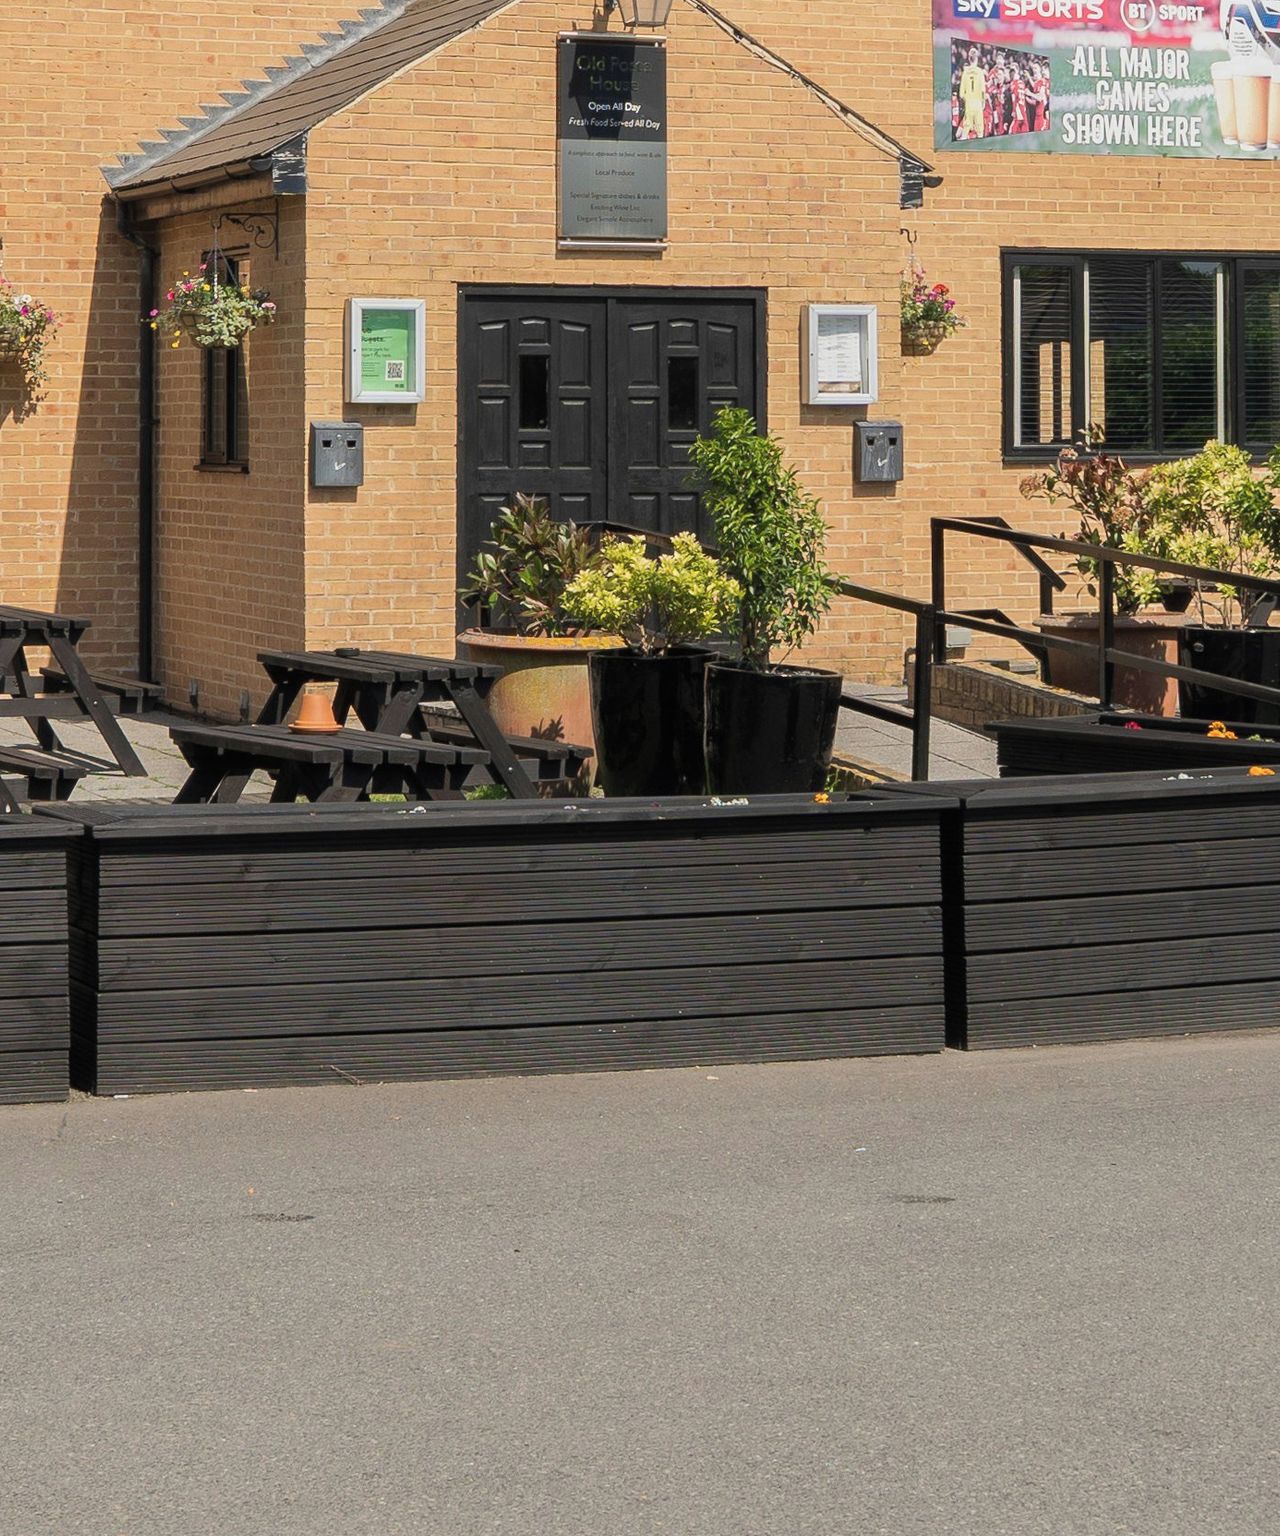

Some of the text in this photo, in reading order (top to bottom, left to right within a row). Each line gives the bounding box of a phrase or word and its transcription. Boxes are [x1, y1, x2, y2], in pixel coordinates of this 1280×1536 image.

[1128, 3, 1147, 19] BT
[1159, 5, 1205, 22] SPORT
[1071, 45, 1190, 80] ALL MAJOR
[588, 101, 611, 113] Open
[624, 102, 642, 114] Day
[1095, 79, 1171, 112] GAMES
[1062, 112, 1202, 147] SHOWN HERE
